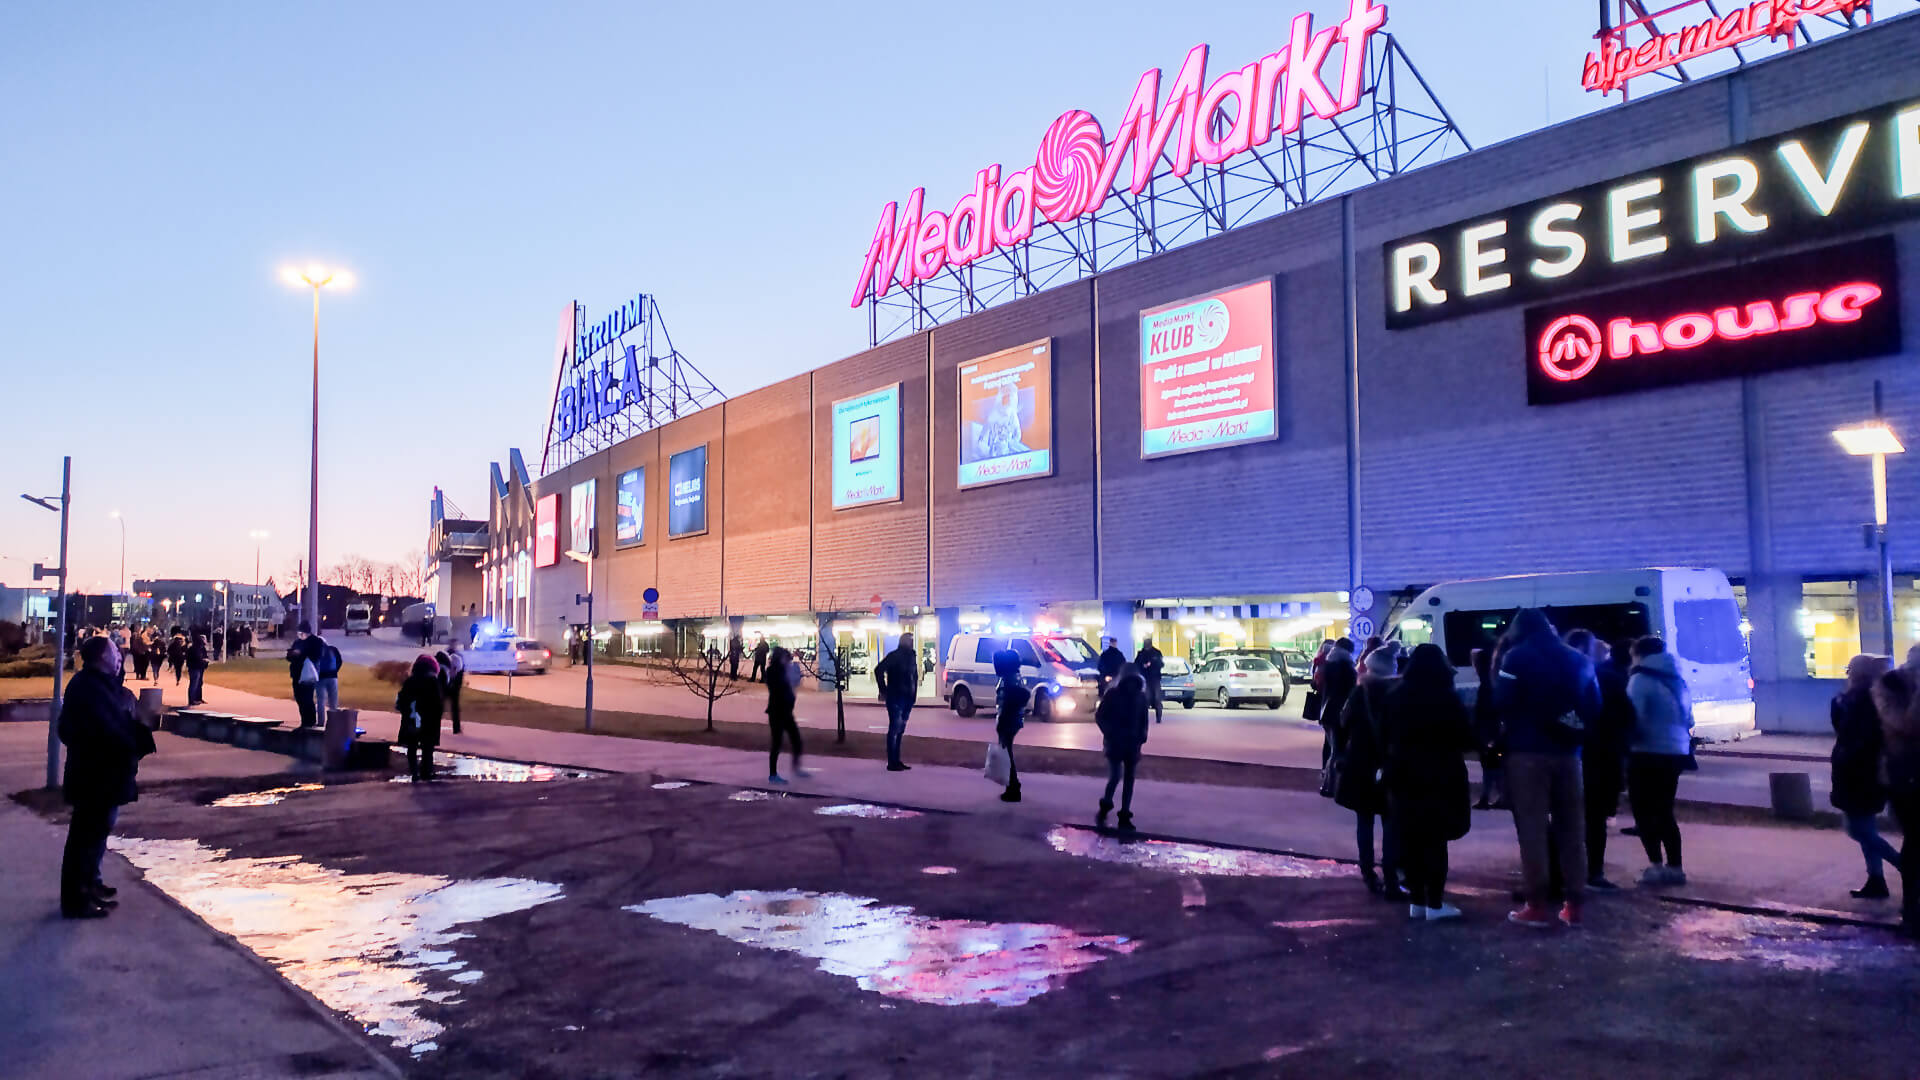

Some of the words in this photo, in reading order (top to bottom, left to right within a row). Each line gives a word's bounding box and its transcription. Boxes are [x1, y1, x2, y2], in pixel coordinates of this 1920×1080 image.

[1581, 0, 1868, 90] hipermark
[850, 162, 1036, 308] Media
[1087, 0, 1387, 213] Markt
[576, 293, 643, 364] ATRIUM
[1150, 324, 1194, 356] KLUB
[1607, 282, 1882, 359] house
[560, 345, 643, 442] BIAŁA
[1357, 621, 1371, 635] 10
